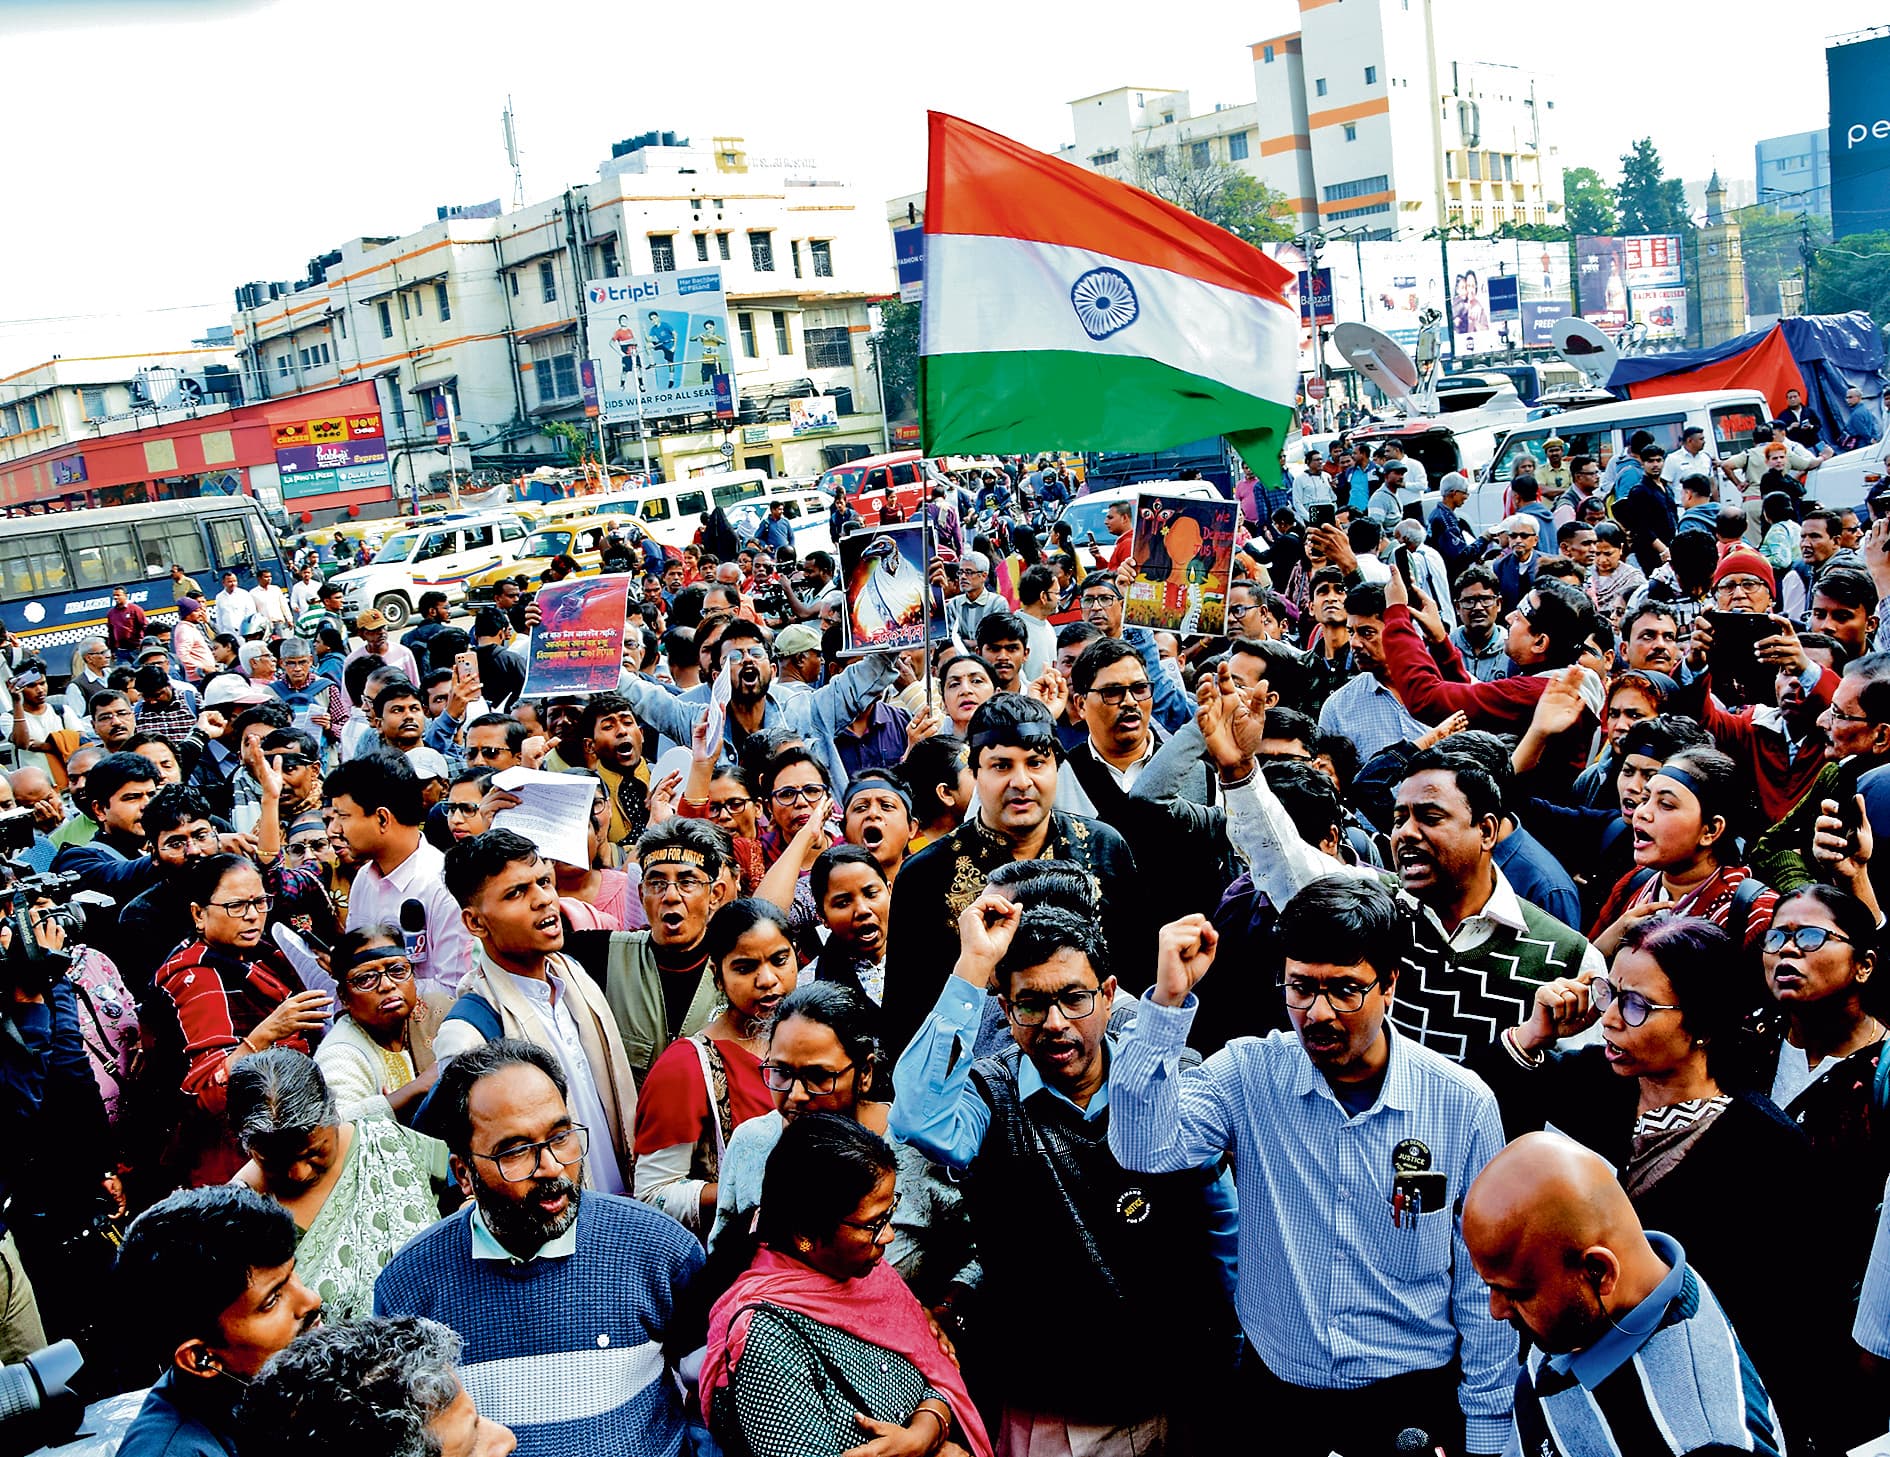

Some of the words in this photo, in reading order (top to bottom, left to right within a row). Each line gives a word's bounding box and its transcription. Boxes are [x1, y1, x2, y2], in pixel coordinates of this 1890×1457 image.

[609, 281, 659, 302] tripti
[655, 393, 673, 402] FOR
[675, 391, 691, 400] ALL
[1215, 509, 1231, 522] We
[667, 847, 680, 861] FOR
[682, 849, 705, 867] JUSTICE
[1409, 1140, 1429, 1154] DEMAND
[1398, 1153, 1425, 1166] JUSTICE
[1124, 1197, 1145, 1217] JUSTICE
